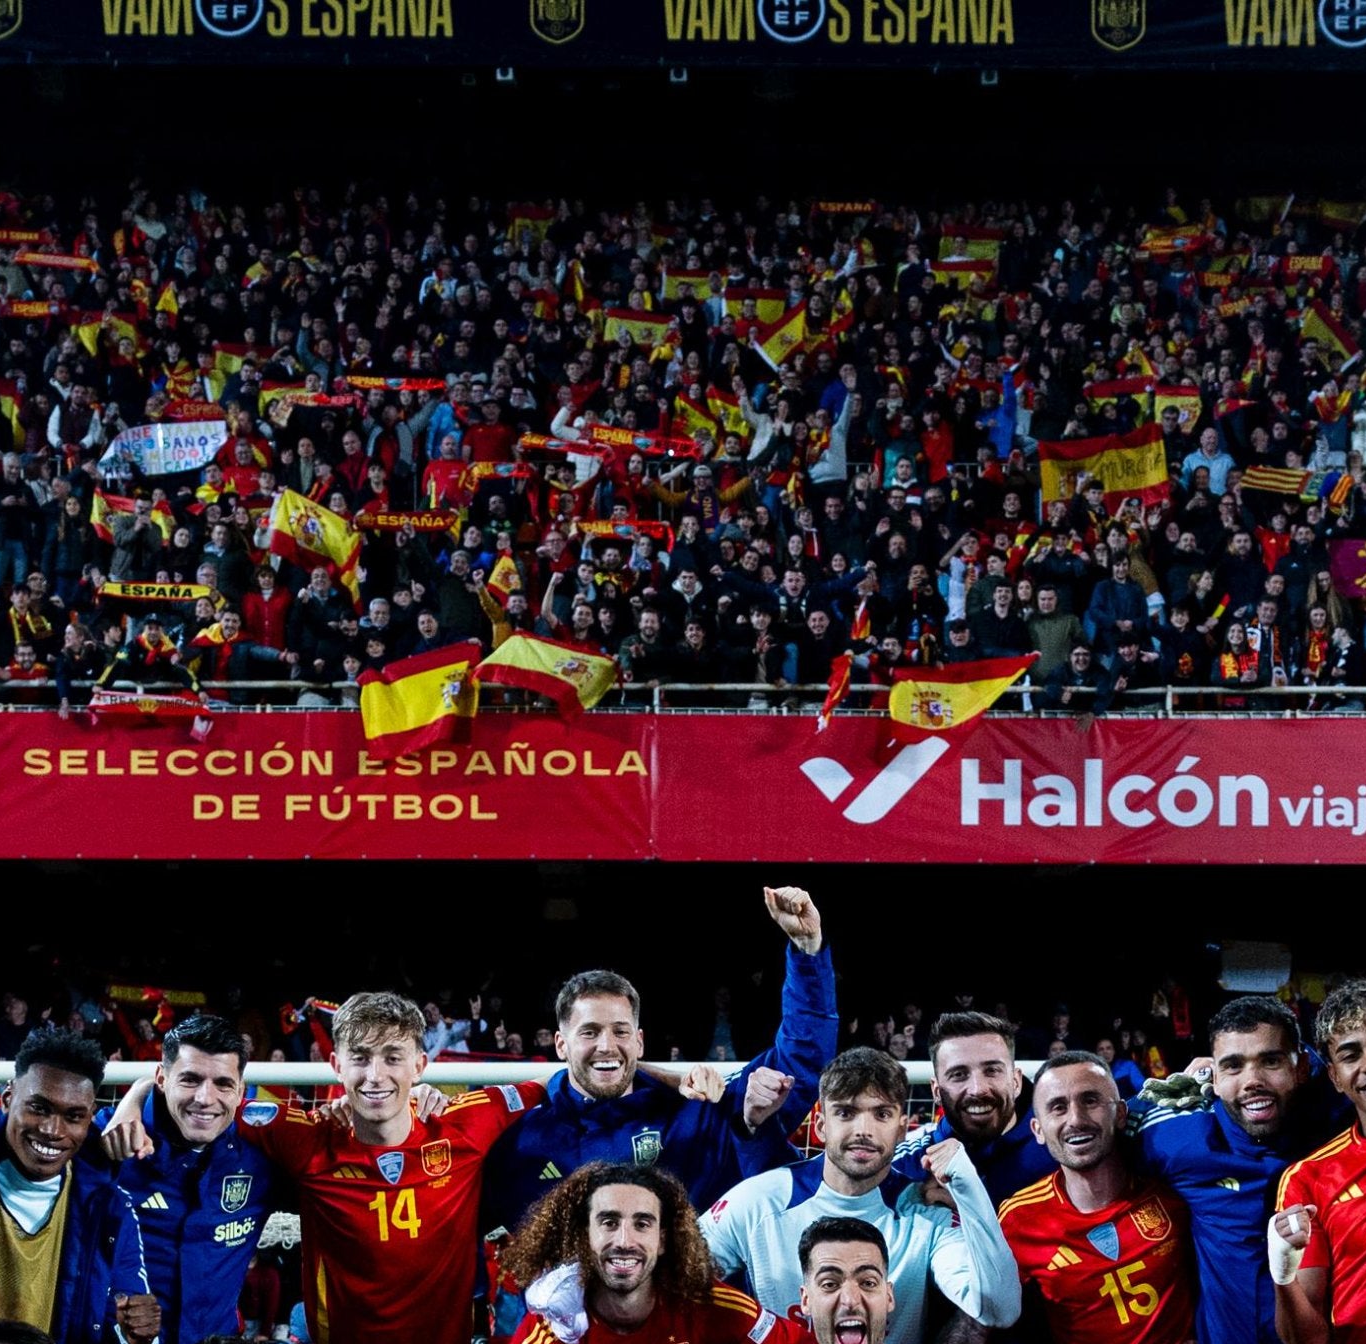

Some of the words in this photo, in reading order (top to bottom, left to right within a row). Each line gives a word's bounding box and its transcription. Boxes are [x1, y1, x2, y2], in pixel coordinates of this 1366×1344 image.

[377, 514, 445, 528] ESPAÑA
[120, 583, 192, 598] ESPAÑA
[23, 741, 333, 777] SELECCIÓN
[356, 743, 648, 779] ESPAÑOLA
[192, 794, 260, 820] DE
[285, 785, 498, 821] FÚTBOL
[960, 754, 1269, 828] Halcón
[369, 1188, 422, 1241] 14
[1099, 1260, 1160, 1325] 15
